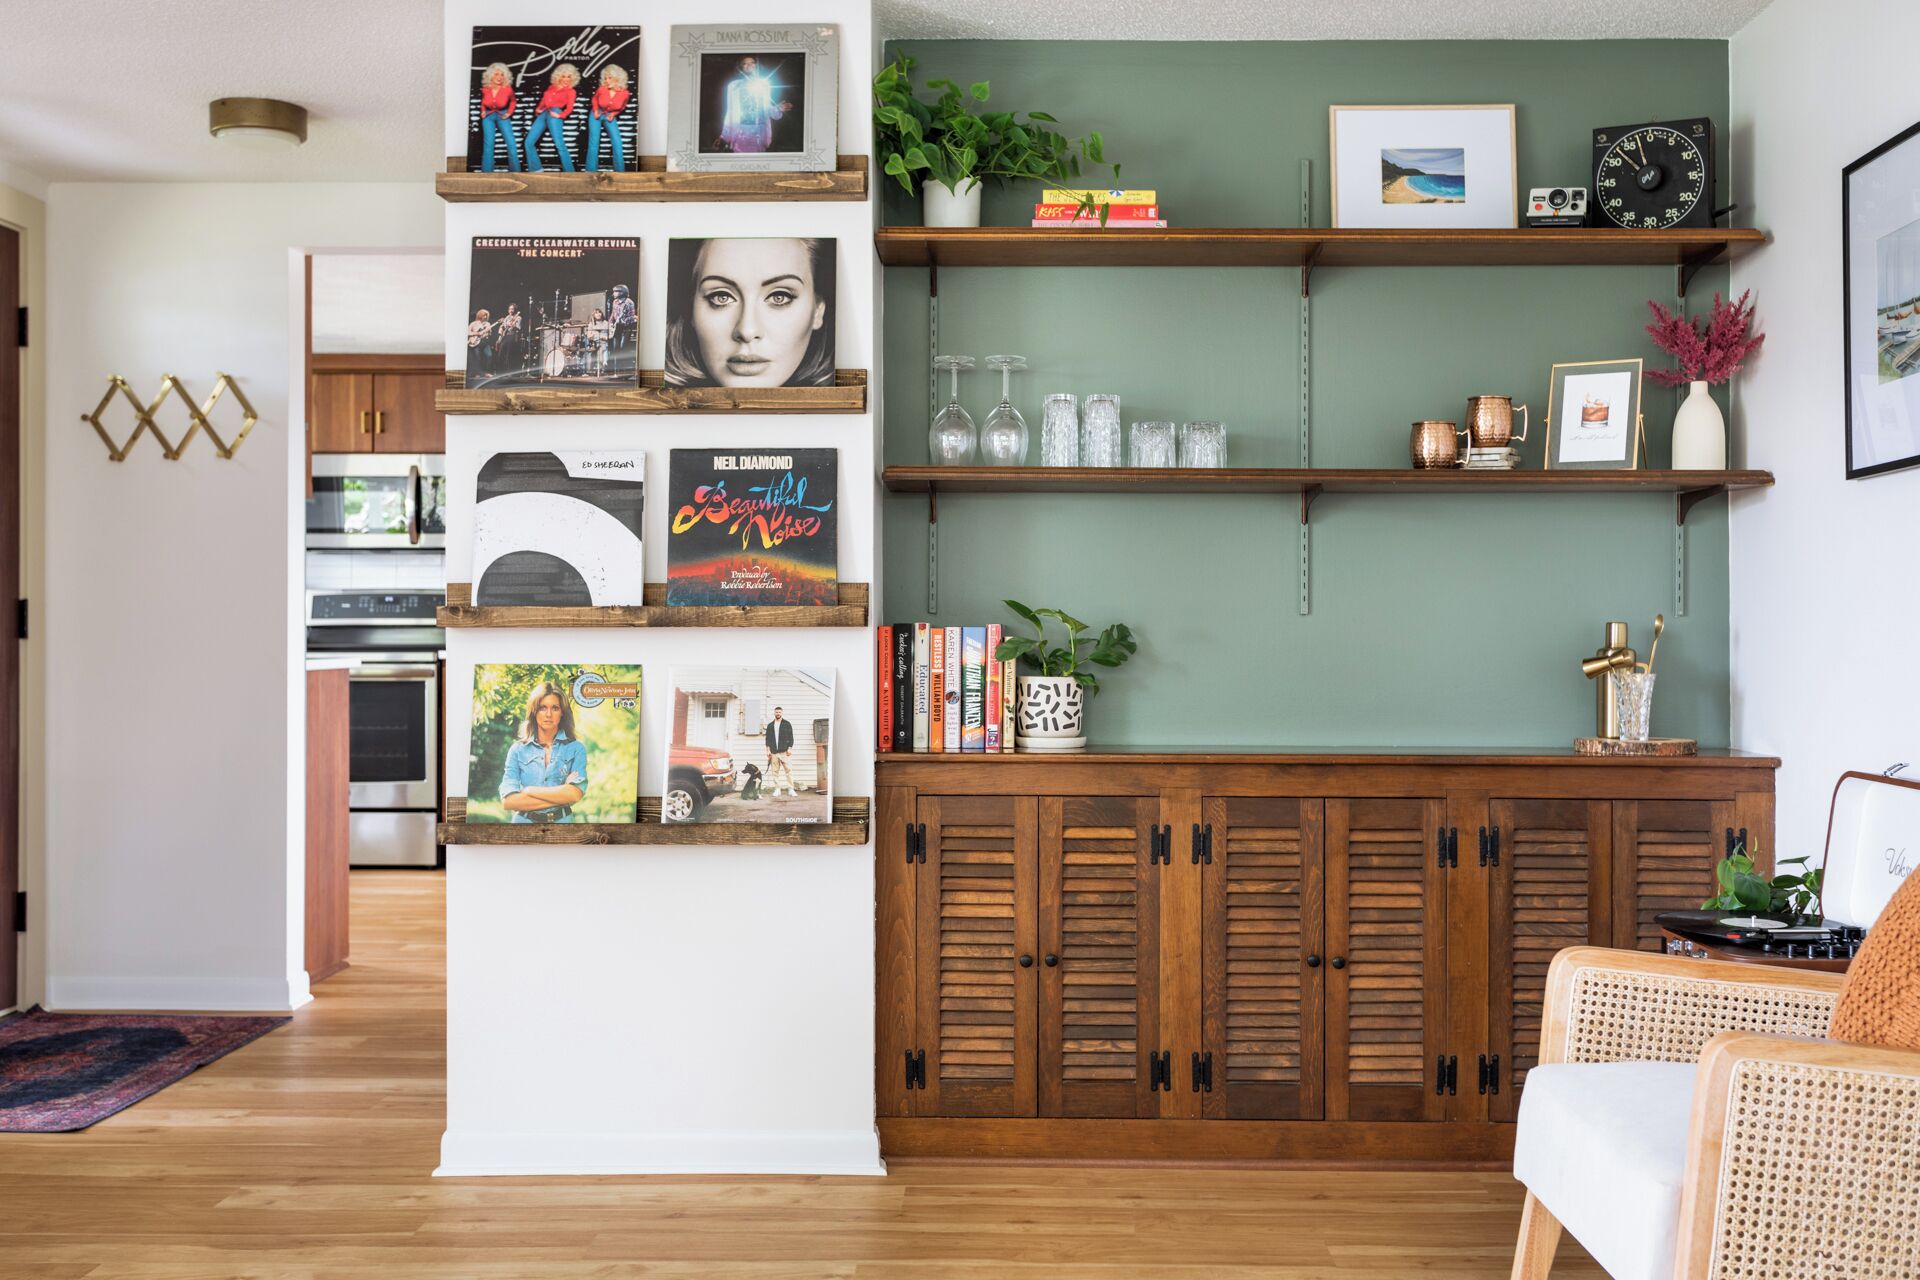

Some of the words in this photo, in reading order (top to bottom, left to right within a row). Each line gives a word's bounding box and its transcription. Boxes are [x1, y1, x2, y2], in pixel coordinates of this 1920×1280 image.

[716, 31, 743, 43] DIANA
[744, 31, 773, 43] ROSS
[774, 31, 790, 43] LIVE
[471, 25, 640, 88] Dolly
[1647, 133, 1653, 142] 0
[1668, 137, 1675, 146] 5
[1623, 141, 1636, 150] 55
[1681, 151, 1692, 160] 10
[1609, 158, 1622, 167] 50
[1688, 171, 1698, 180] 15
[1603, 178, 1616, 187] 45
[1609, 198, 1622, 207] 40
[1679, 192, 1692, 201] 20
[1623, 211, 1635, 221] 35
[1665, 208, 1678, 217] 25
[1644, 216, 1657, 226] 30
[476, 239, 531, 247] CREEDENCE
[533, 239, 596, 247] CLEARWATER
[597, 239, 637, 247] REVIVAL
[582, 461, 593, 469] ED
[594, 460, 634, 469] SHEERAN
[713, 456, 738, 470] NEIL
[740, 455, 793, 470] DIAMOND
[672, 471, 833, 535] Beautiful
[728, 511, 821, 551] Noise
[731, 566, 760, 579] Produced
[760, 566, 771, 580] by
[720, 579, 746, 589] Robbie
[746, 577, 783, 589] Robertson
[947, 630, 957, 659] KAREN
[933, 634, 943, 668] RESTLESS
[896, 656, 907, 680] calling
[965, 645, 982, 690] JONATHAN
[947, 661, 957, 688] WHITE
[918, 664, 928, 714] Educated
[933, 673, 942, 704] WILLIAM
[933, 704, 942, 722] BOYD
[965, 691, 982, 730] FRANZEN
